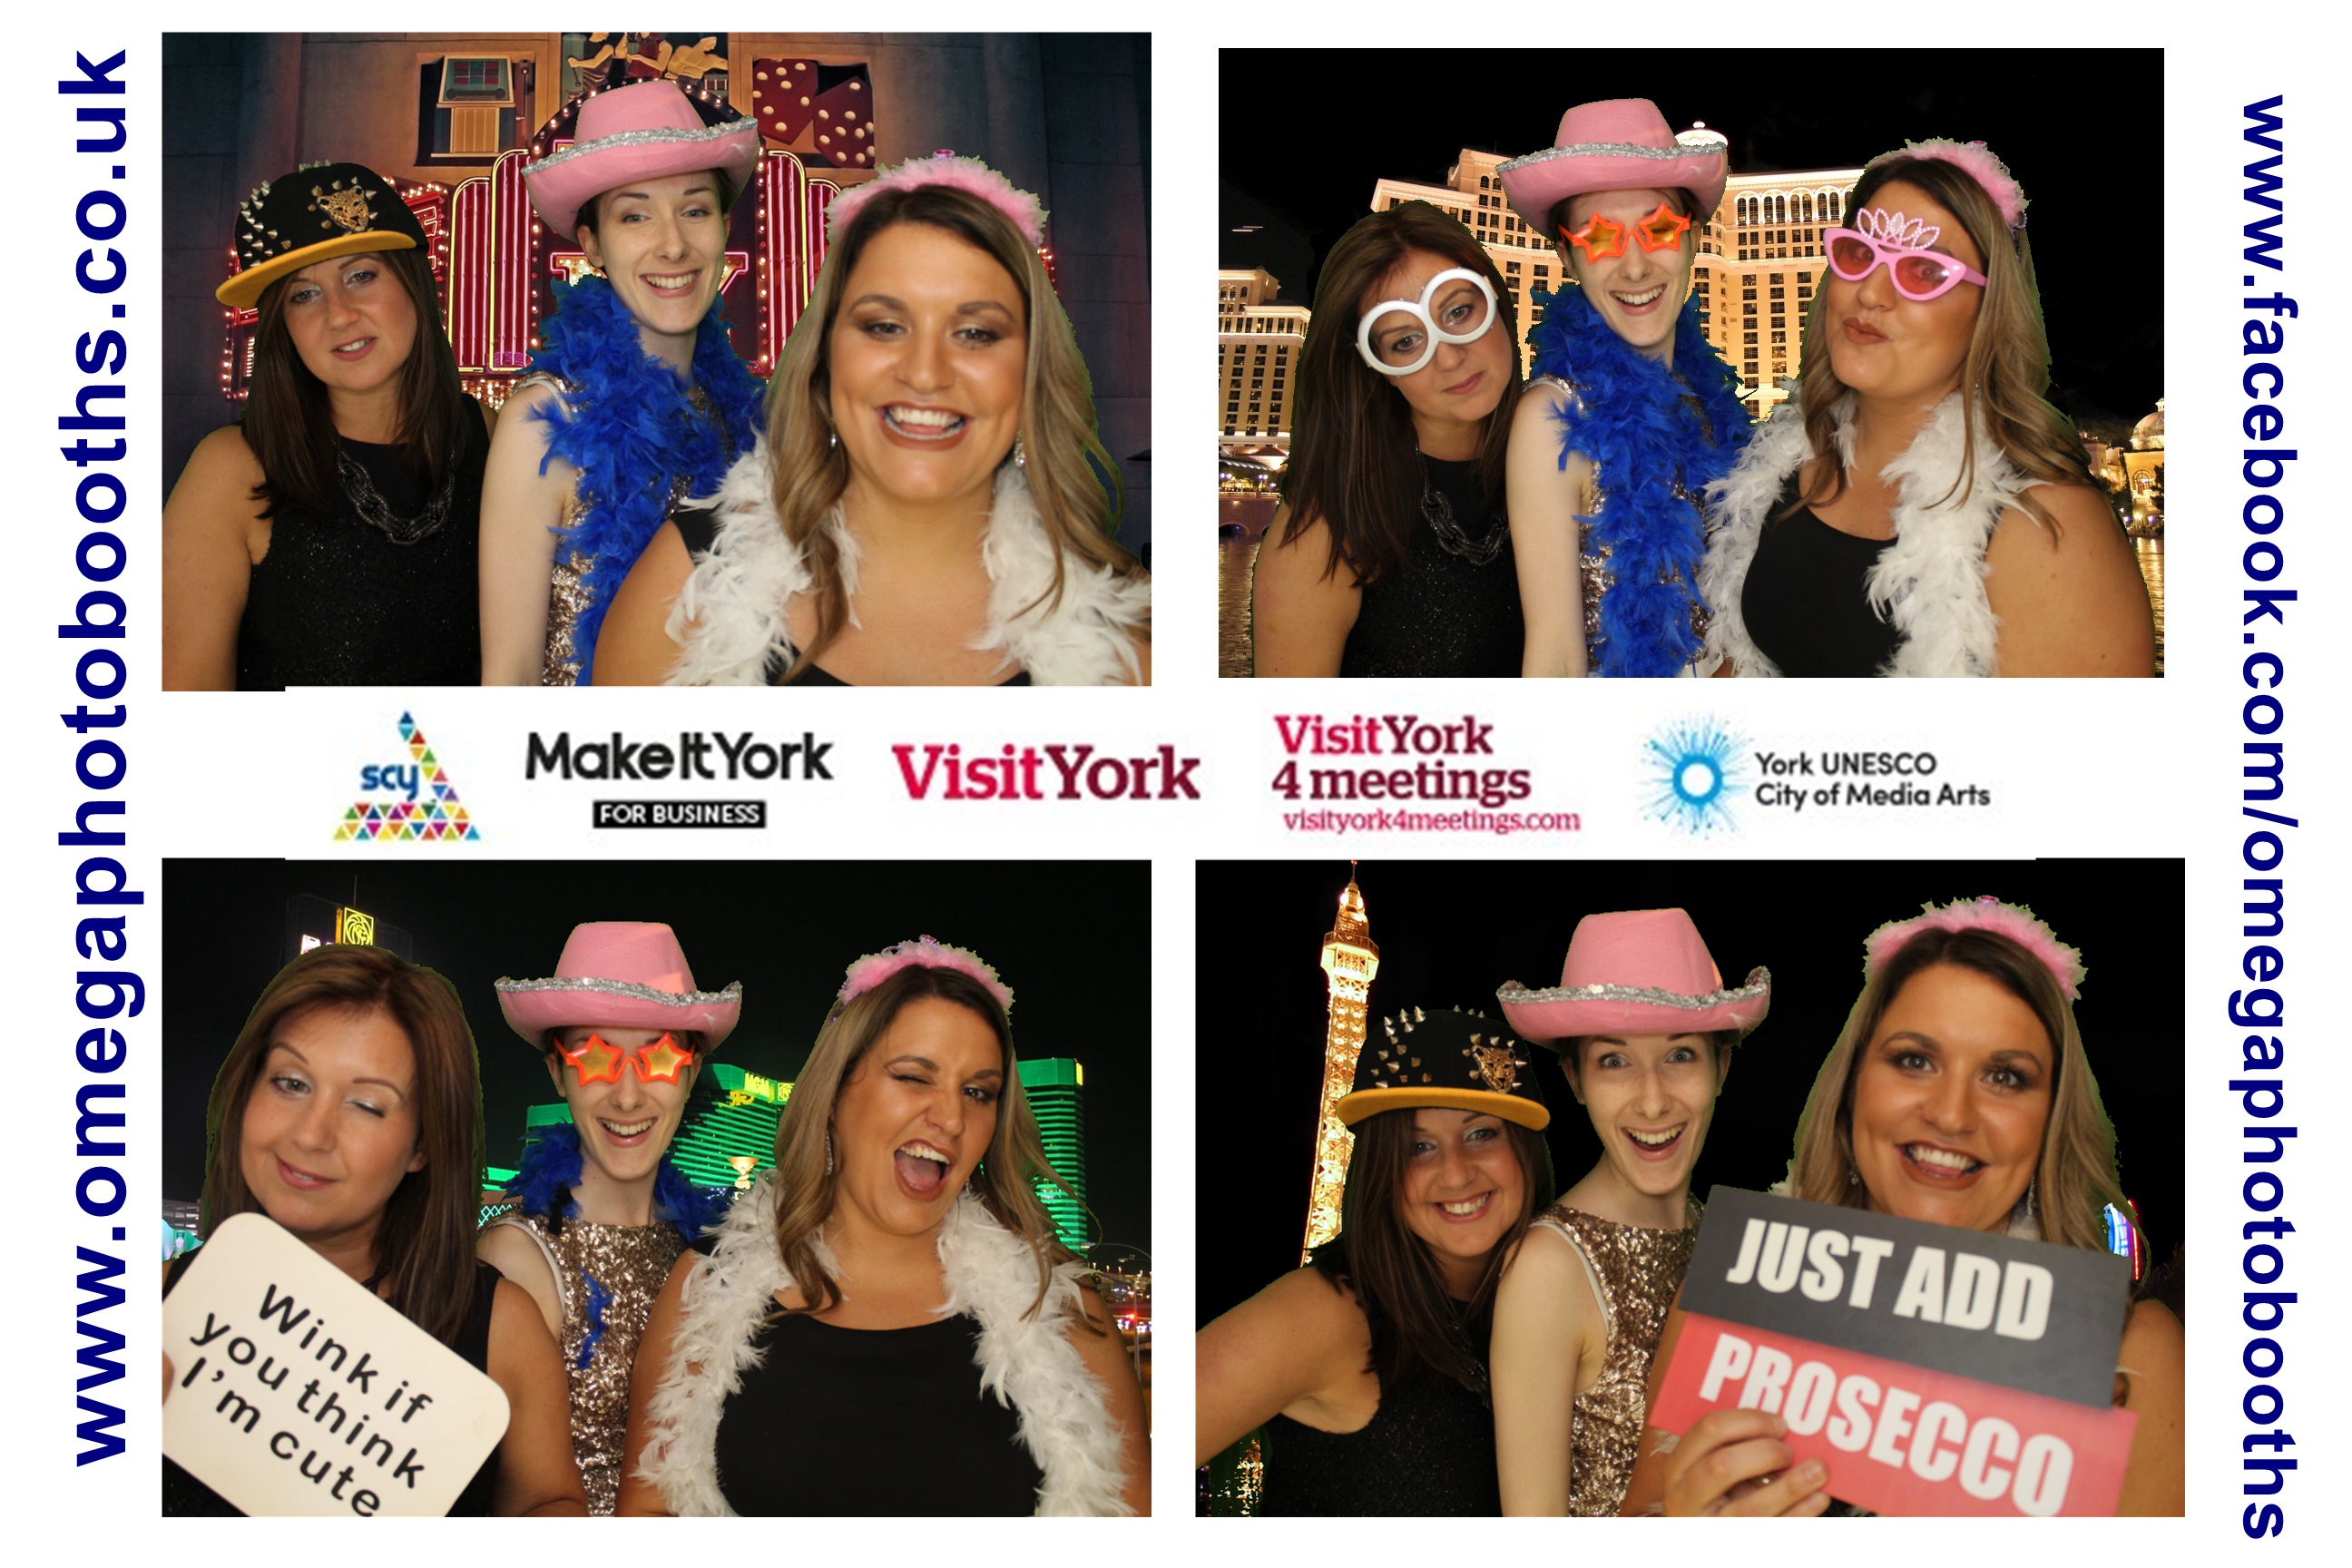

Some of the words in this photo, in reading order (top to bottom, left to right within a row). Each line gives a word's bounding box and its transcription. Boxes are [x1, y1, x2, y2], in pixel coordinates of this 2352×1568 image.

[259, 1284, 378, 1394] Wink
[385, 1380, 433, 1423] if
[1726, 1218, 1895, 1309] JUST
[1892, 1246, 2054, 1341] ADD
[181, 1357, 261, 1434] I'm
[270, 1430, 381, 1517] cute
[190, 1312, 289, 1390] you
[296, 1379, 426, 1489] think
[1699, 1333, 2074, 1516] PROSECCO
